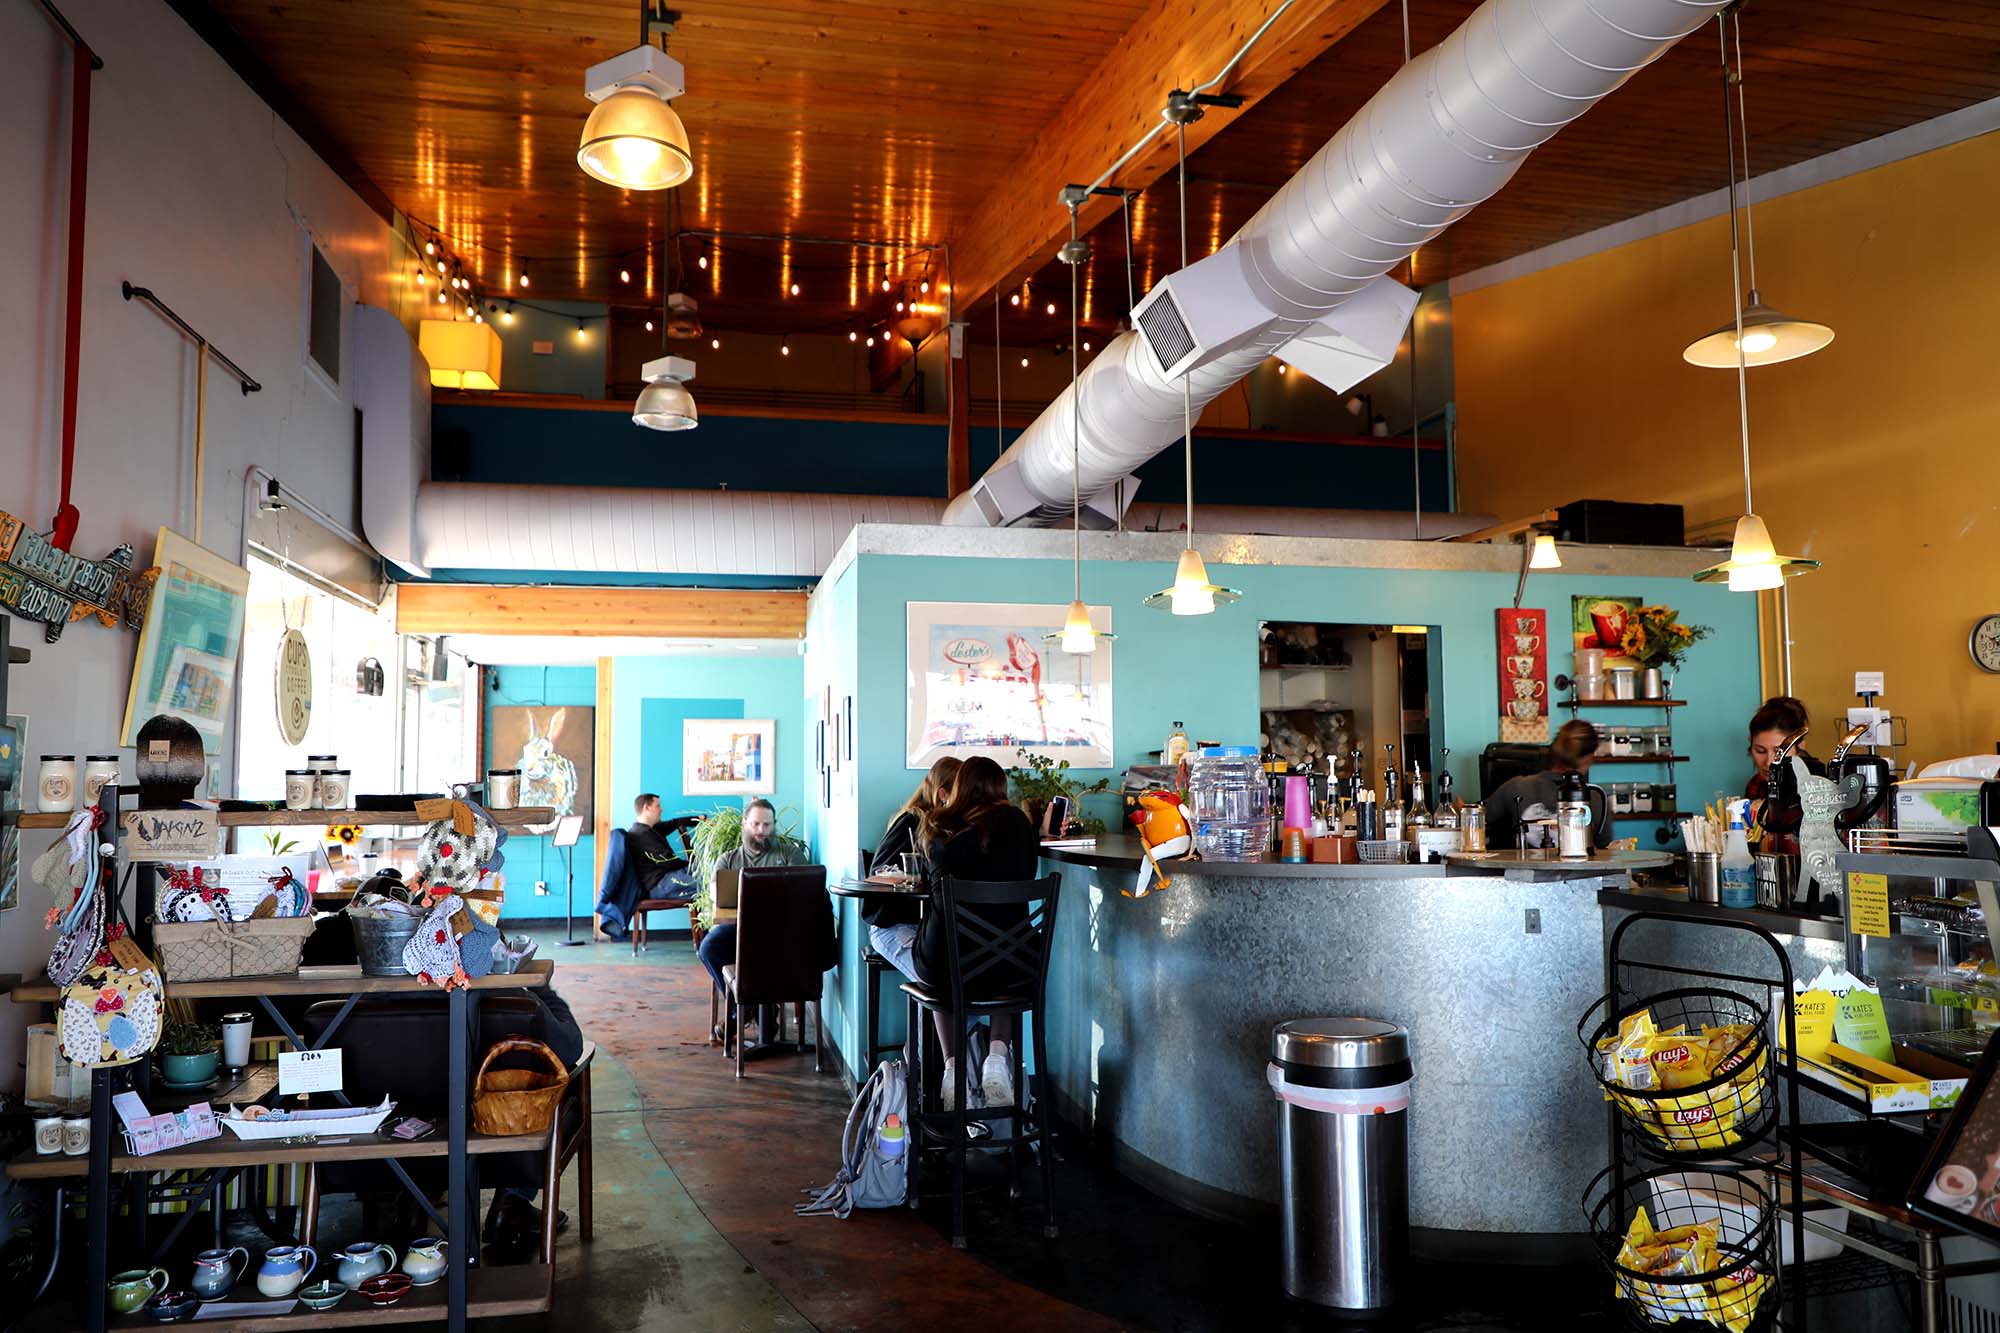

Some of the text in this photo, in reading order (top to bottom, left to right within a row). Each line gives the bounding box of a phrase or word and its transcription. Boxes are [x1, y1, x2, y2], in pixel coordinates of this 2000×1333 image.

[287, 639, 307, 667] CUPS
[1756, 880, 1778, 908] LOCAL
[1804, 1002, 1825, 1011] KATE'S
[1657, 1045, 1688, 1063] Lay's
[1676, 1106, 1710, 1124] Lay's
